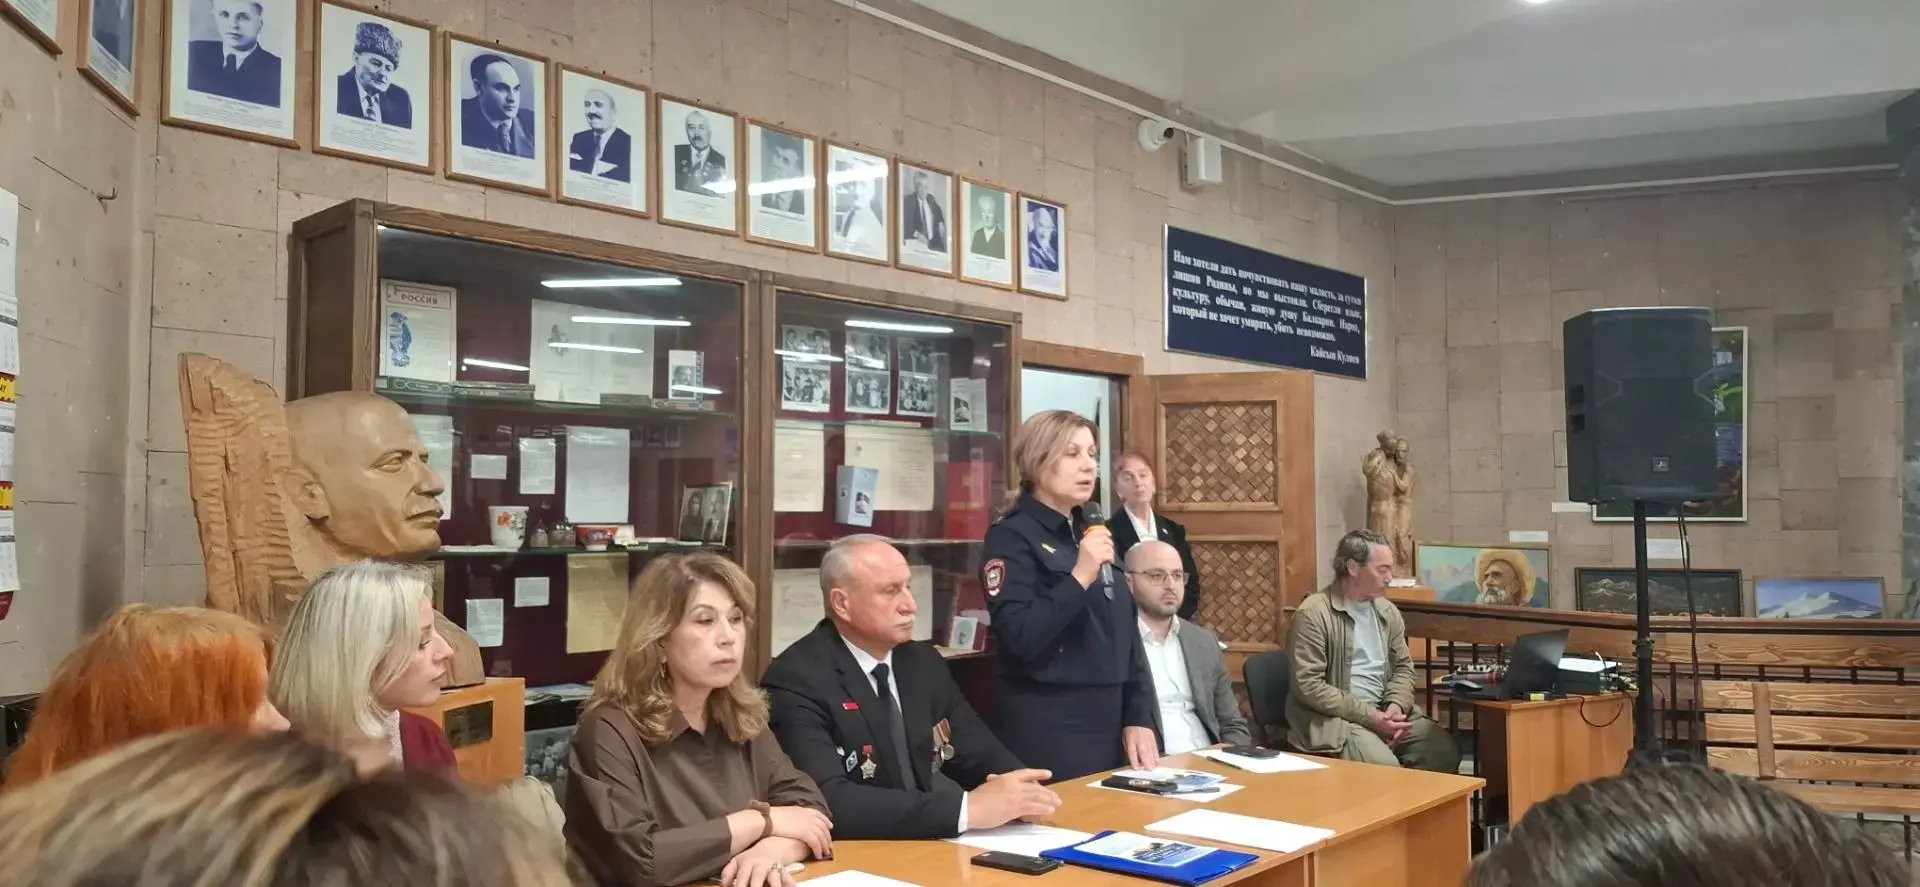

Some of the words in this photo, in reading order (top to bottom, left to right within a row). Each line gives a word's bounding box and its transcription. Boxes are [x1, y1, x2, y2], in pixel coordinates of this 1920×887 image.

[1173, 249, 1191, 266] Нам
[1193, 257, 1219, 272] хотели
[1220, 264, 1237, 277] дать
[1290, 281, 1308, 296] нашу
[1206, 274, 1238, 295] Родины,
[1242, 286, 1253, 296] но
[1256, 289, 1269, 300] мы
[1172, 287, 1211, 306] культуру,
[1250, 303, 1276, 317] живую
[1280, 309, 1298, 322] душу
[1172, 304, 1208, 320] который
[1208, 311, 1219, 322] не
[1219, 313, 1240, 325] хочет
[1274, 321, 1294, 334] убить
[1310, 344, 1337, 361] Кайсын
[1336, 349, 1360, 364] Кулиев
